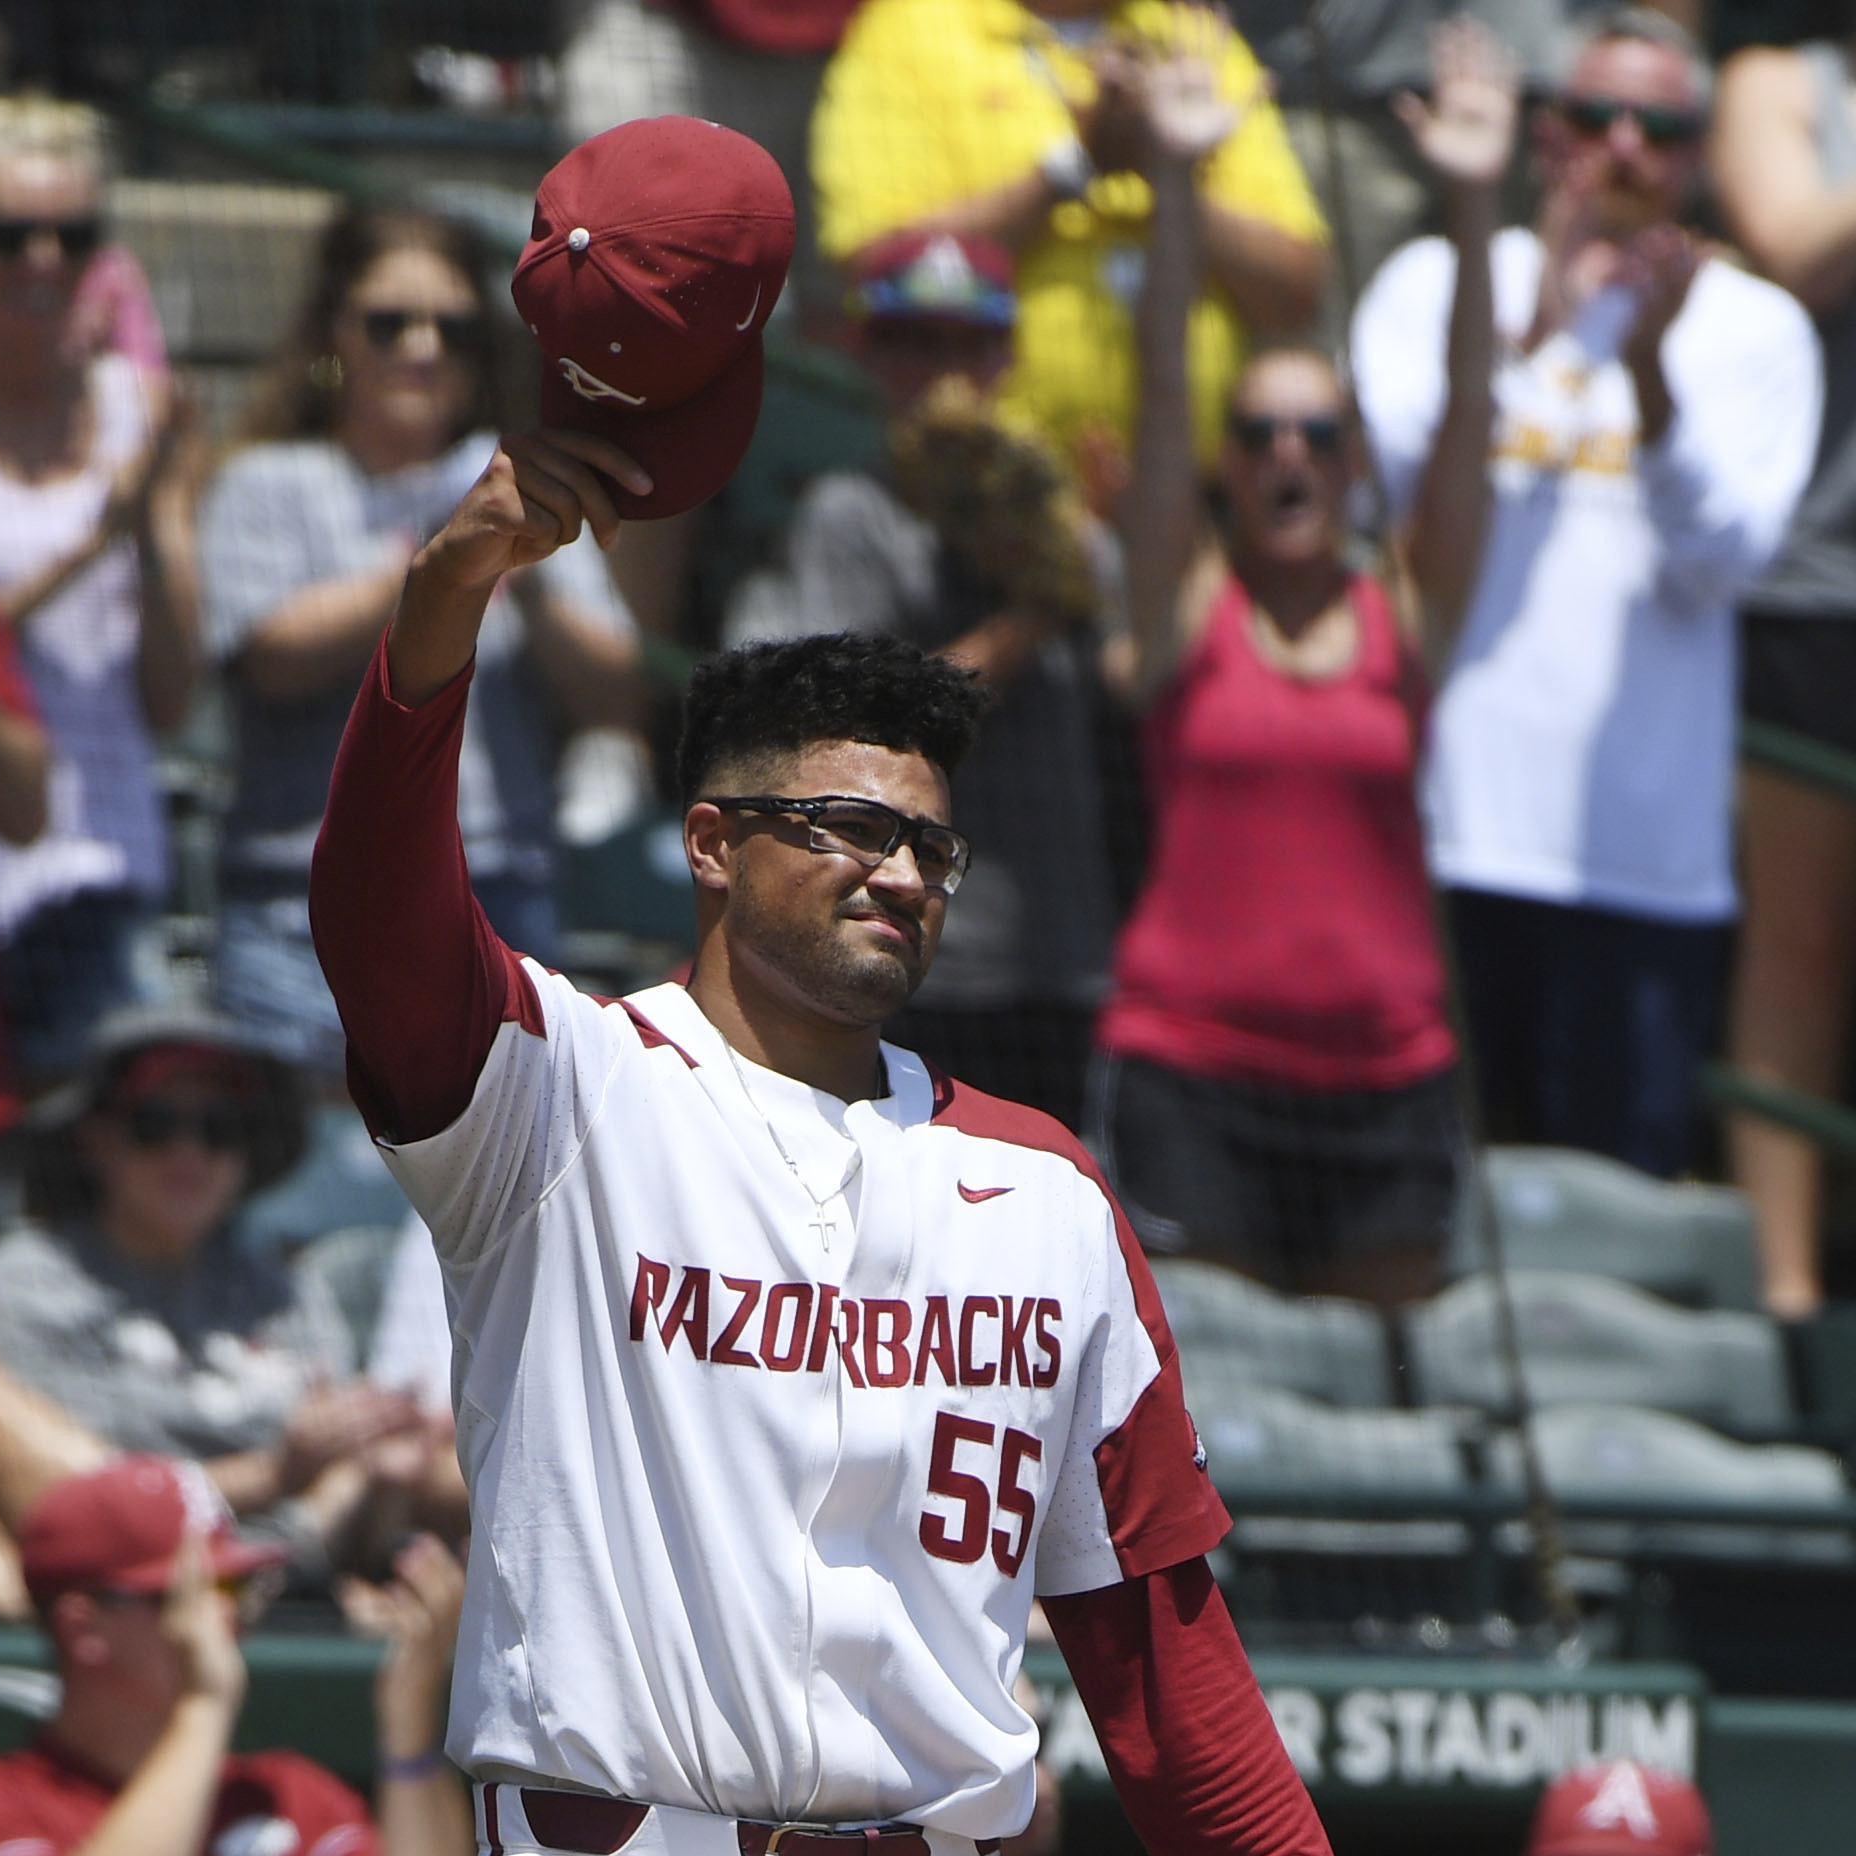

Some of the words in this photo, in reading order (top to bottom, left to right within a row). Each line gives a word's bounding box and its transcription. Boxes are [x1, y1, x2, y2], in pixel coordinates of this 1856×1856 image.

[629, 1250, 1063, 1389] RAZORBACKS
[918, 1409, 1043, 1580] 55
[1333, 1687, 1696, 1788] STADIUM
[1574, 1757, 1662, 1841] A
